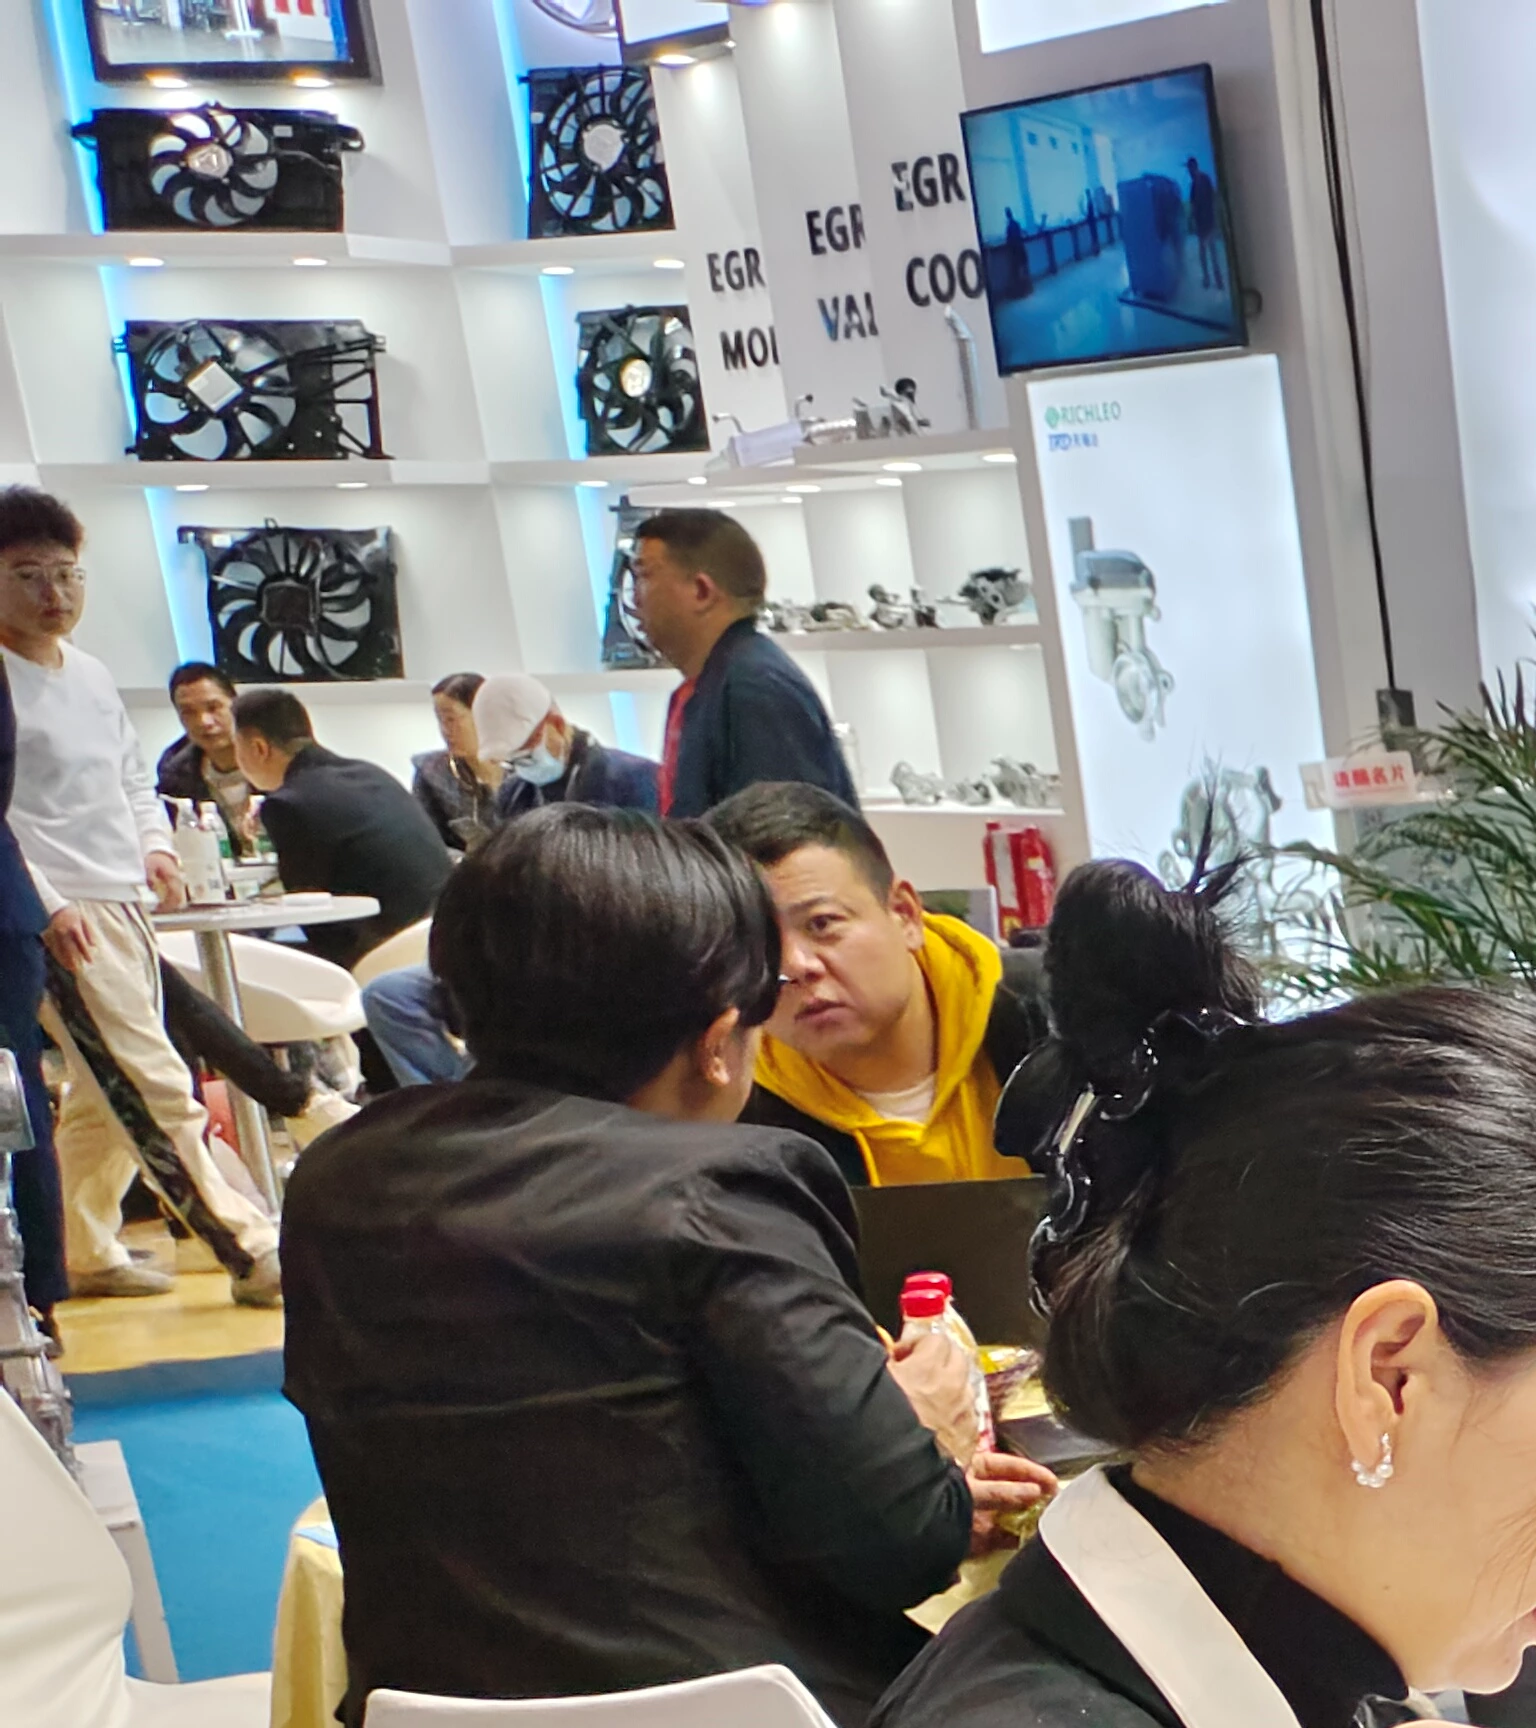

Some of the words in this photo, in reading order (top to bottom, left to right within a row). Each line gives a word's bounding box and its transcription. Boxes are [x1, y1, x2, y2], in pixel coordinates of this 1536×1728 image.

[890, 152, 966, 212] EGR
[706, 247, 766, 293] EGR
[905, 248, 986, 307] COO
